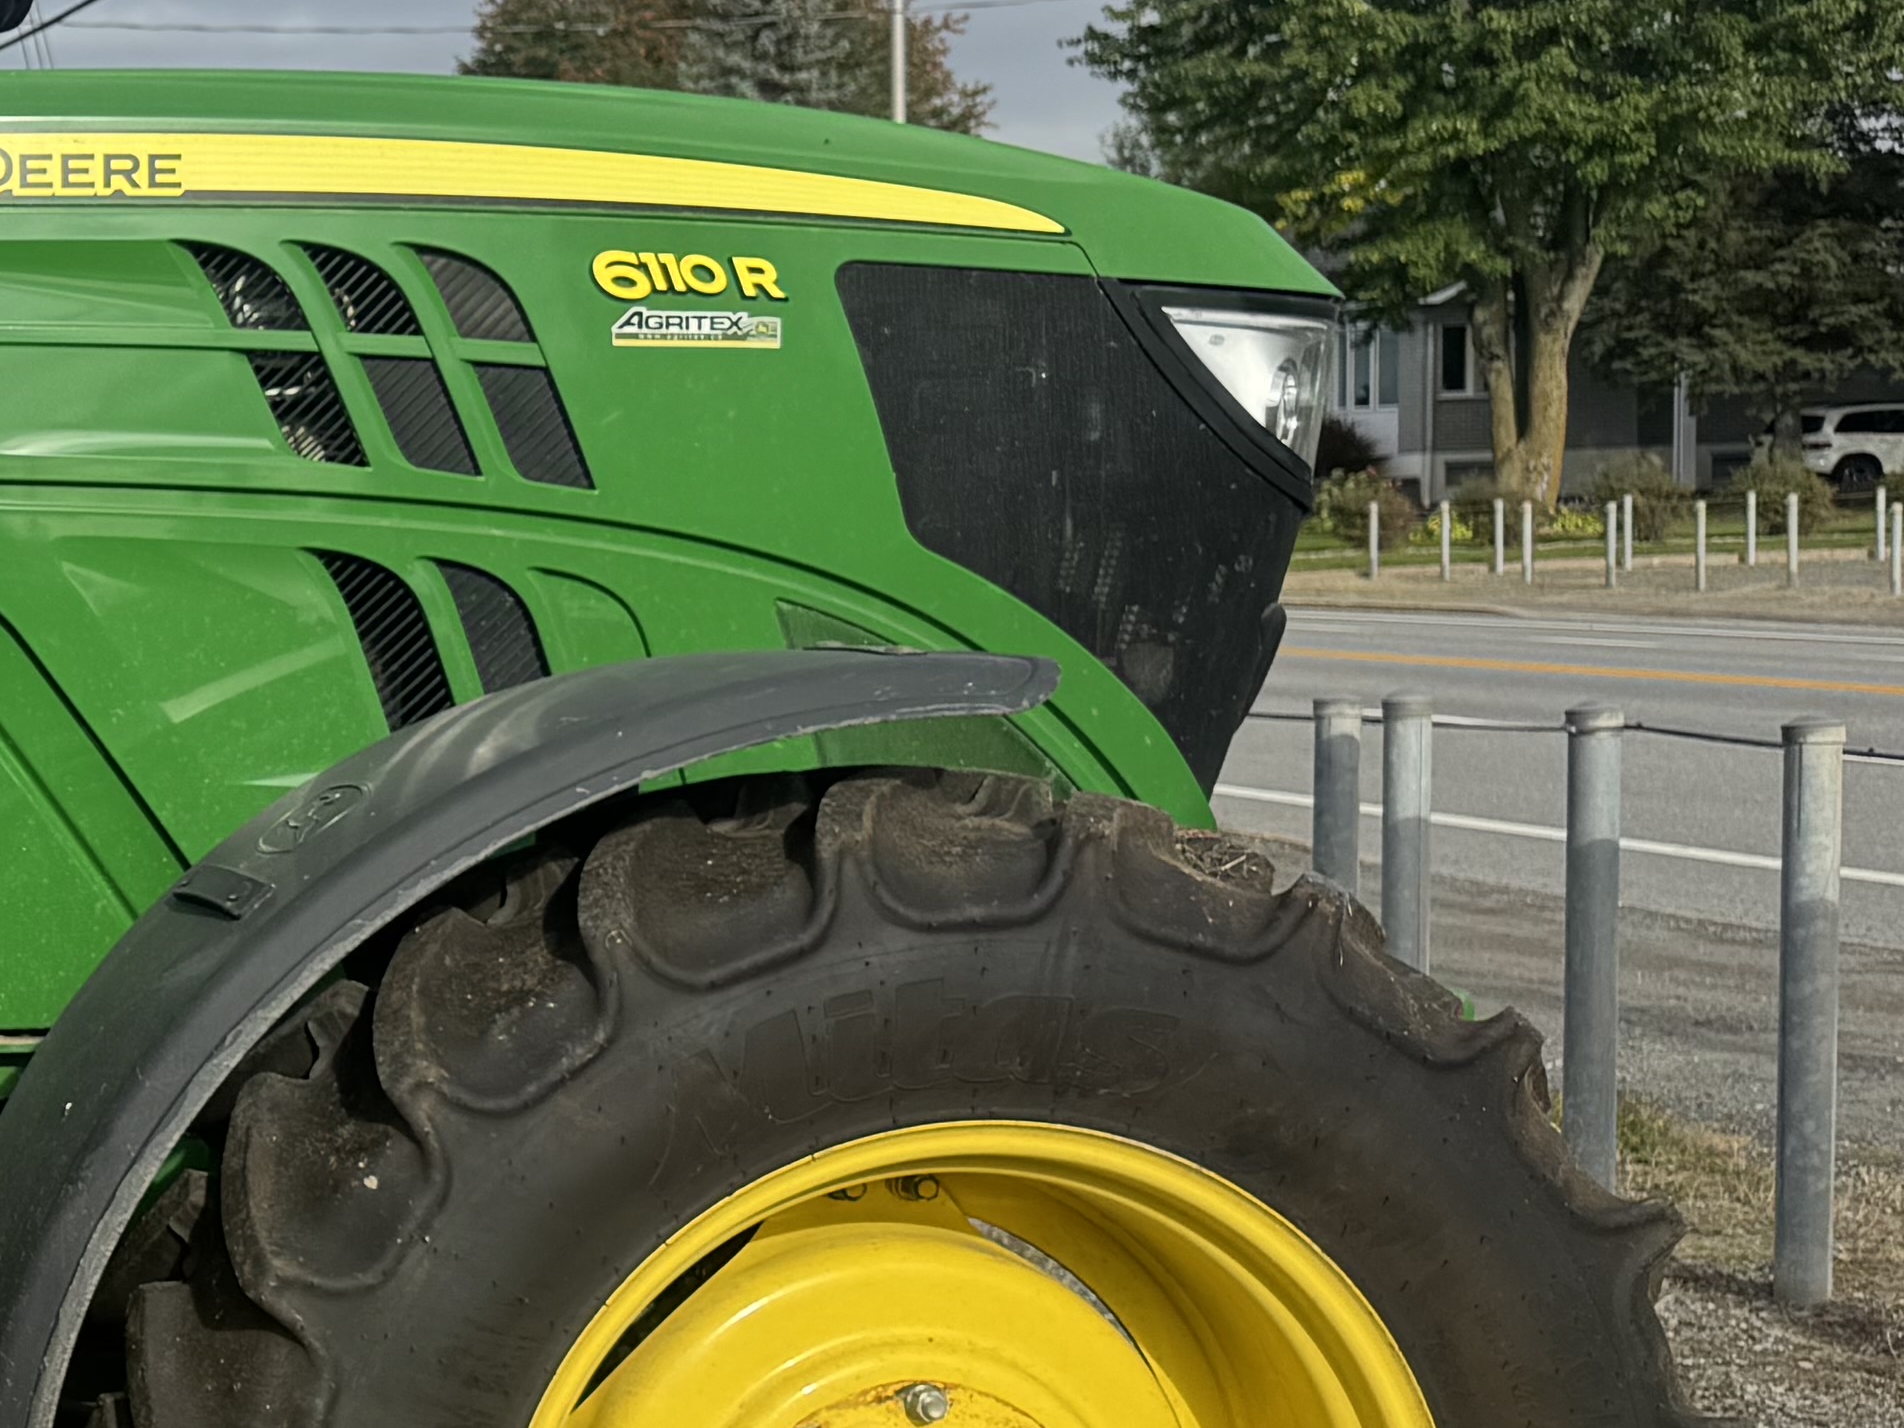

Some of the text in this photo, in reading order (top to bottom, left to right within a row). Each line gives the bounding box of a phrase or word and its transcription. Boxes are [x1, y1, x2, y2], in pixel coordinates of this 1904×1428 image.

[593, 249, 787, 300] 6110 R
[617, 311, 743, 331] AGRITEX
